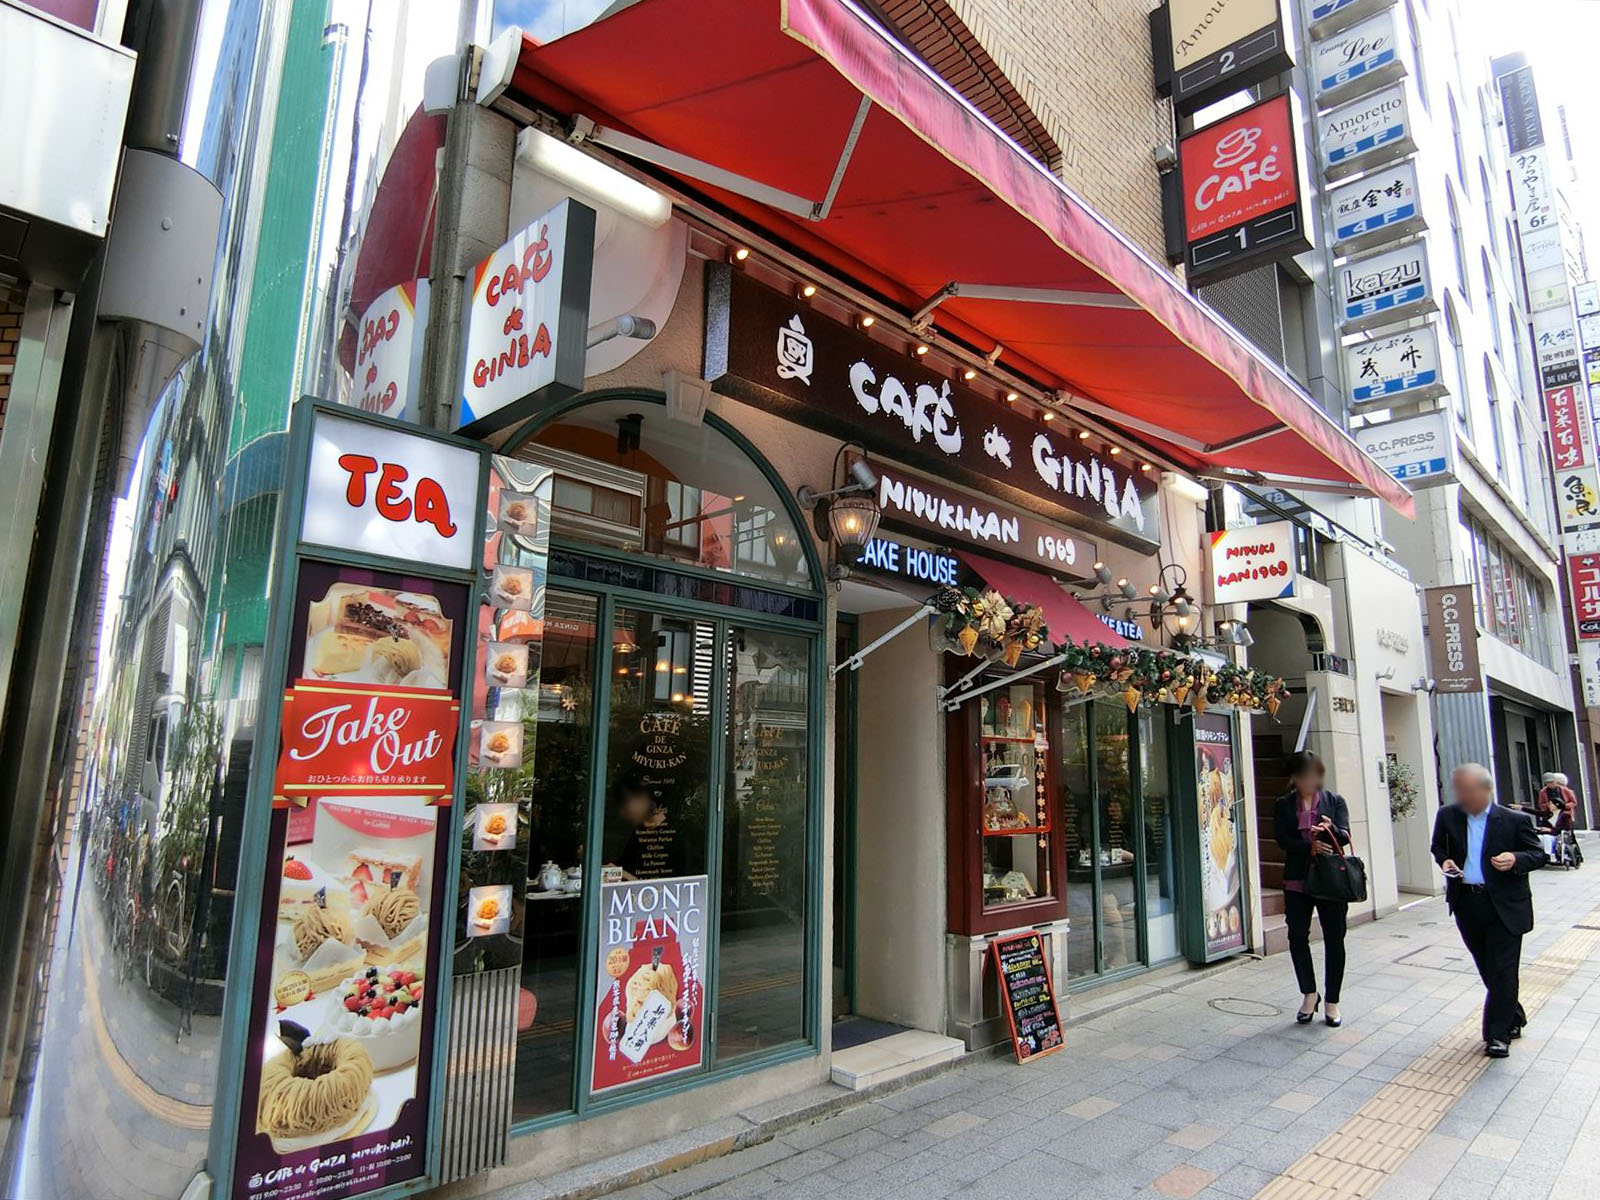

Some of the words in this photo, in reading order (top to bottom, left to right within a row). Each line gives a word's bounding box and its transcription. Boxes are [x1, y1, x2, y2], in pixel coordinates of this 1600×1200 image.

[1176, 0, 1230, 56] Amou
[1219, 50, 1235, 75] 2
[1338, 35, 1391, 67] Lee
[1326, 98, 1402, 137] Amoretto
[1338, 115, 1391, 141] アマレット
[1234, 226, 1247, 249] 1
[1529, 214, 1548, 228] 6F
[1344, 260, 1420, 298] kazu
[473, 322, 552, 388] GINZA
[338, 454, 458, 539] TEA
[1031, 433, 1146, 535] GINZA
[1563, 474, 1598, 516] 魚民
[856, 538, 899, 572] AKE
[906, 546, 958, 587] HOUSE
[1036, 535, 1077, 566] 1969
[1226, 542, 1275, 560] MIYUKI
[290, 696, 412, 761] Take
[654, 735, 667, 745] DE
[370, 728, 443, 775] Out
[631, 751, 688, 770] MIYUKI-KAN
[646, 744, 673, 755] GINZA
[307, 773, 428, 785] おひとつからお持ち帰り承ります
[608, 882, 700, 917] MONT
[608, 908, 701, 945] BLANC
